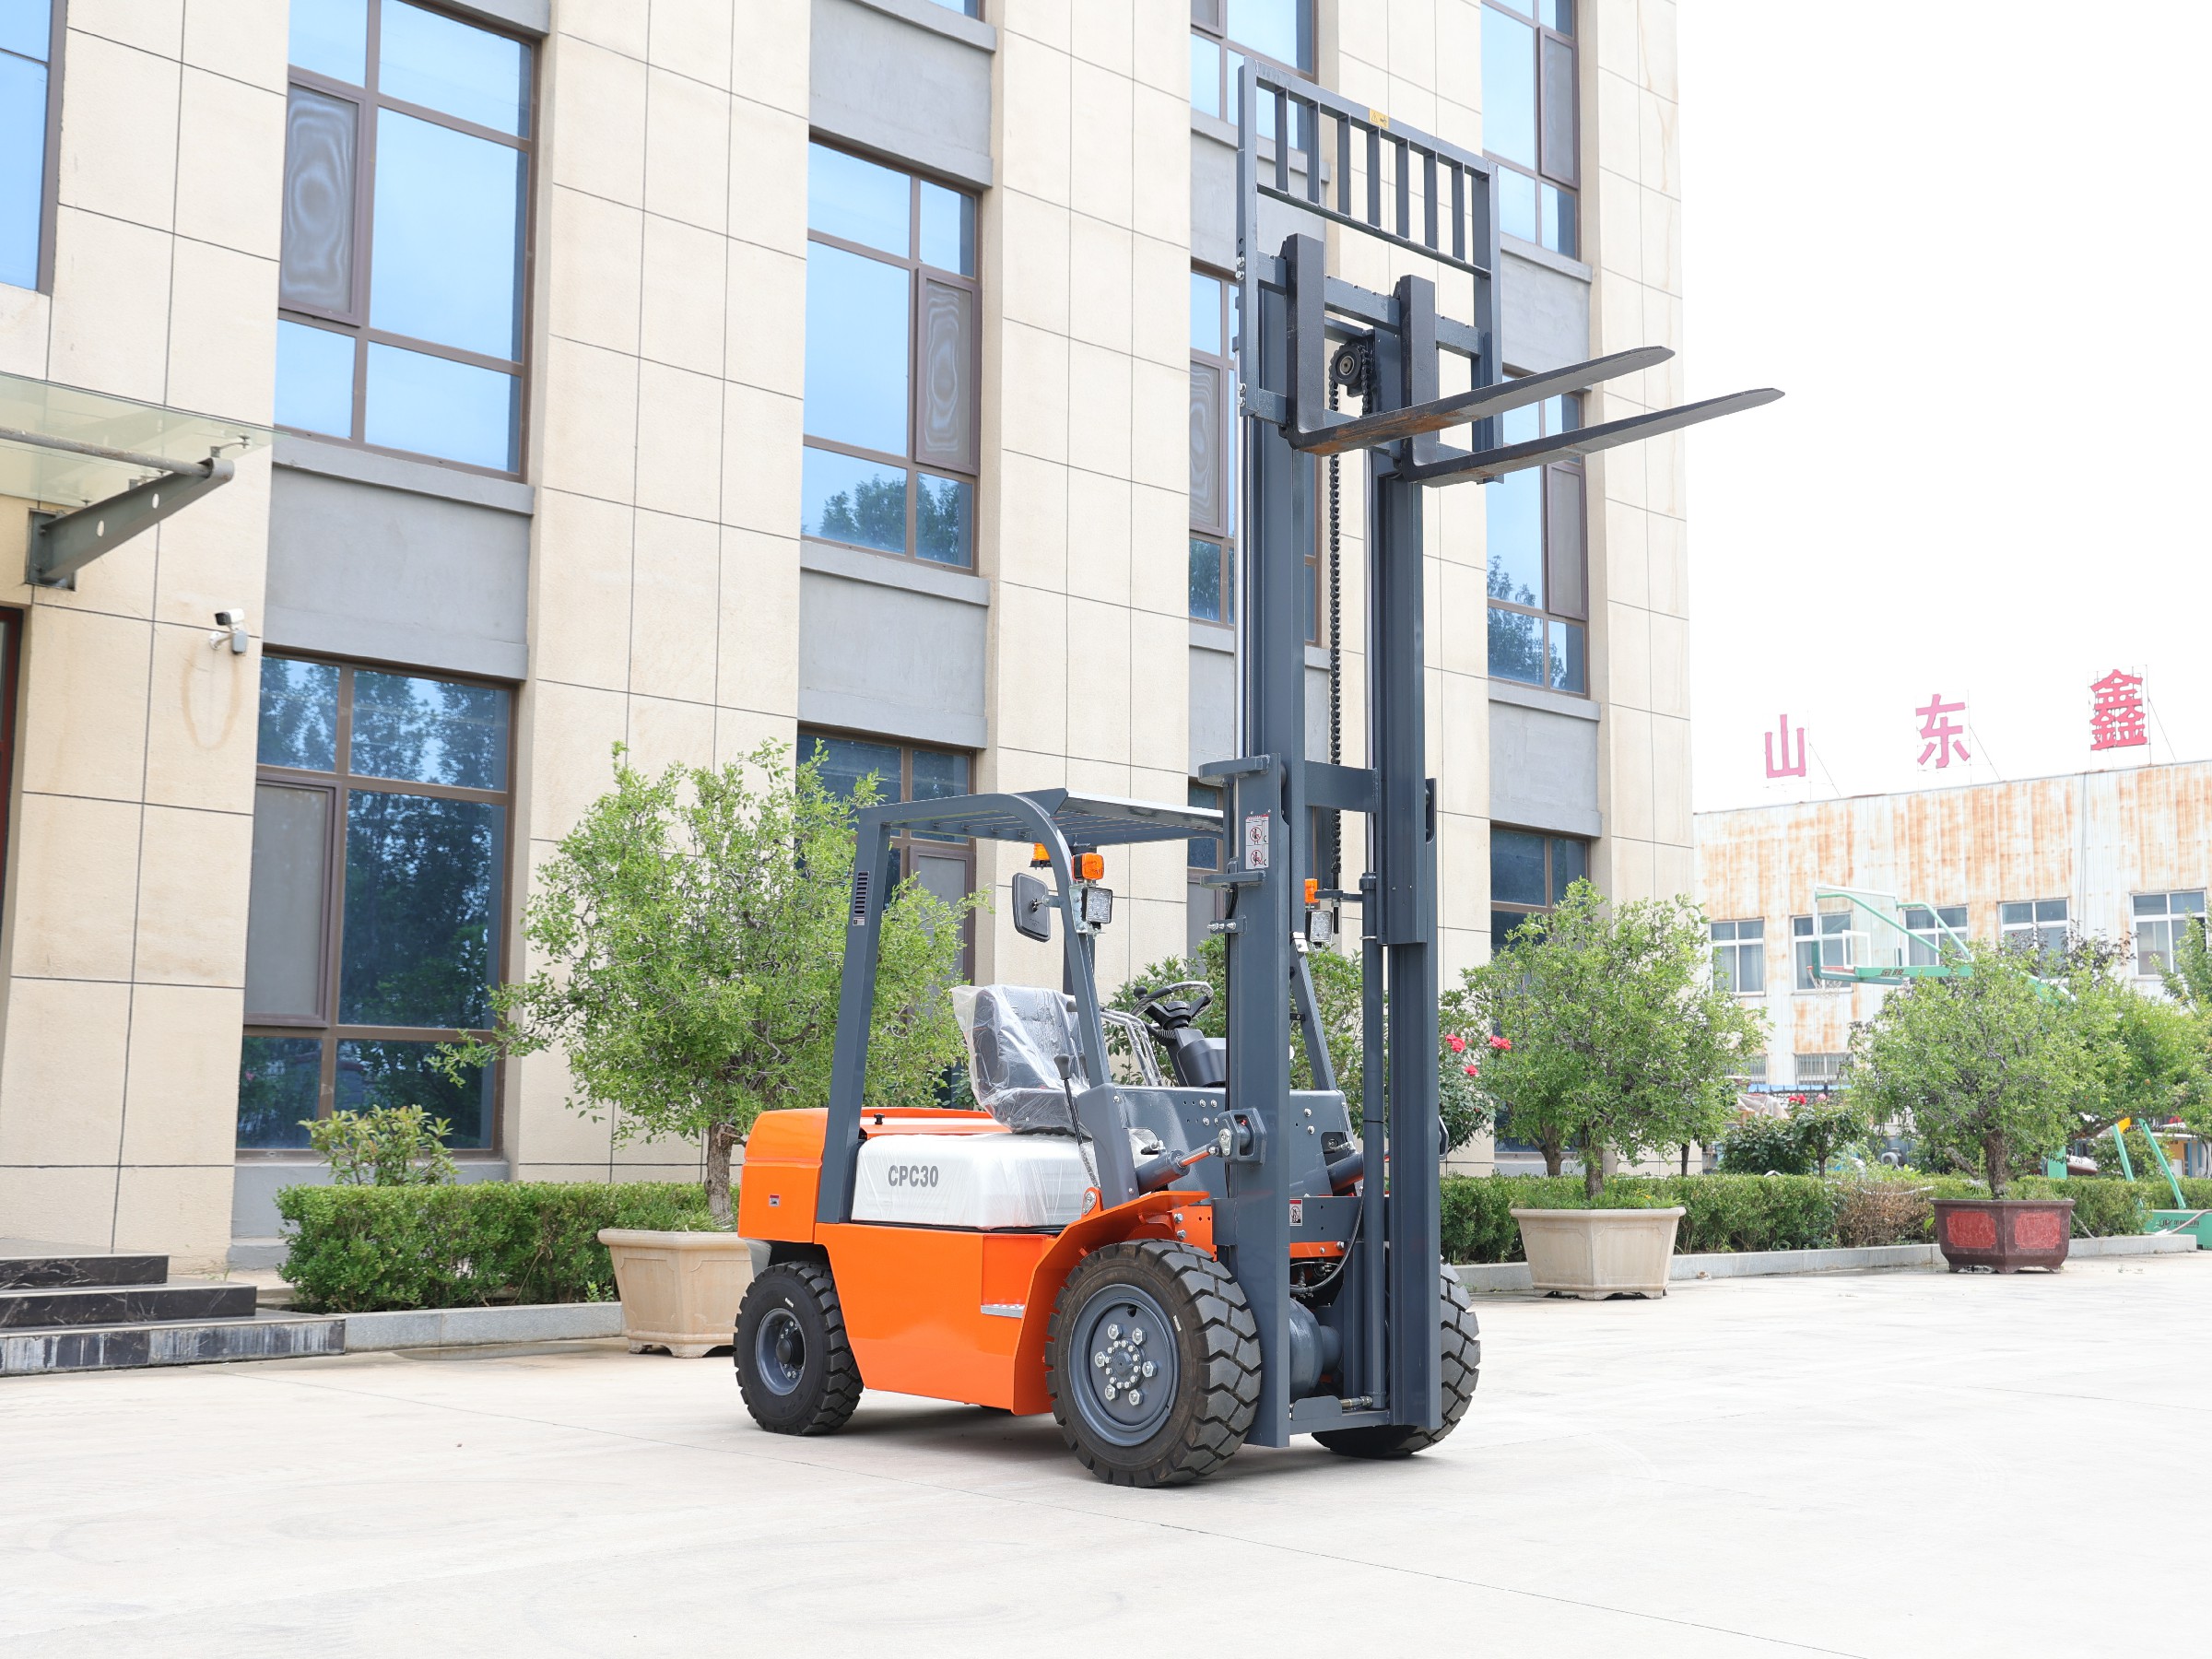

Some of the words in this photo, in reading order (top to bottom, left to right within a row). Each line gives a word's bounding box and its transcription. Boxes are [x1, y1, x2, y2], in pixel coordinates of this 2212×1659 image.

[1765, 669, 2148, 779] 山东鑫
[888, 1165, 939, 1187] CPC30
